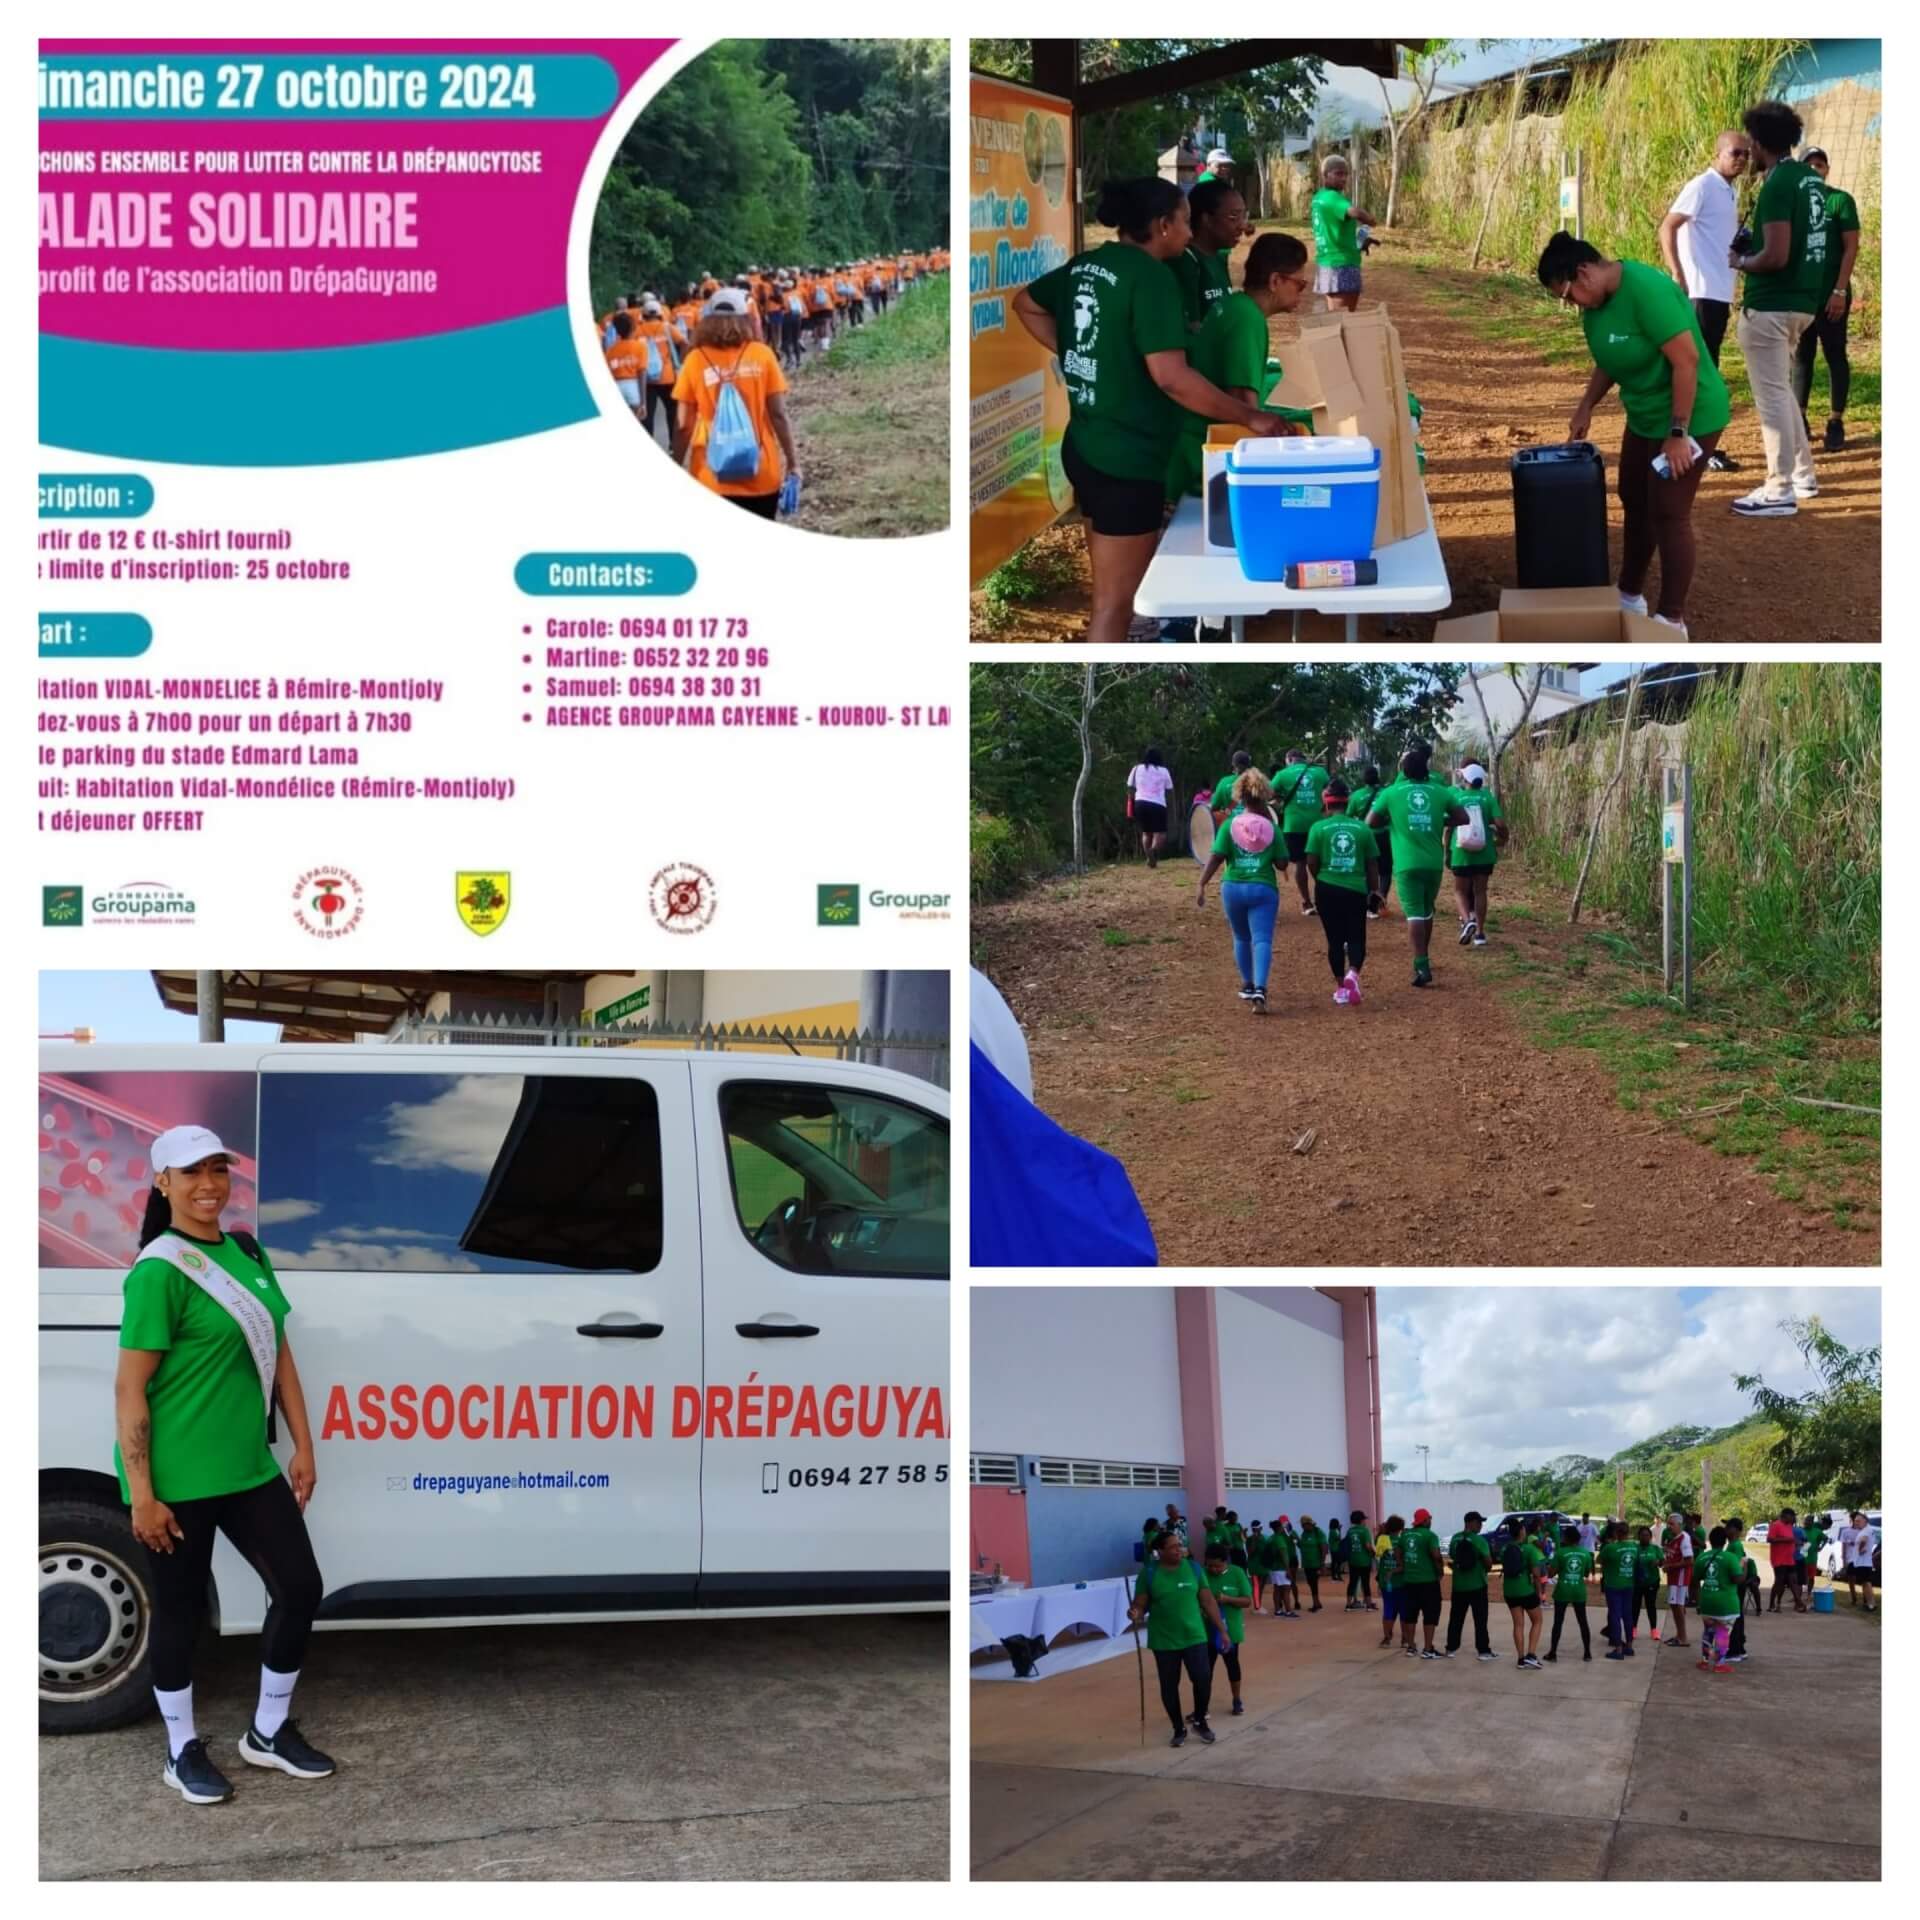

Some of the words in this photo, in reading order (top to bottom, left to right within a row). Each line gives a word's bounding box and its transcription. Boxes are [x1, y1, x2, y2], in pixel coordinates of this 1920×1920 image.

[38, 62, 205, 109] imanche
[217, 64, 264, 108] 27
[276, 64, 427, 109] octobre
[439, 64, 536, 108] 2024
[100, 150, 190, 173] ENSEMBLE
[194, 150, 240, 173] POUR
[243, 150, 304, 173] LUTTER
[308, 151, 373, 173] CONTRE
[376, 151, 398, 173] LA
[402, 146, 542, 173] DRÉPANOCYTOSE
[38, 191, 173, 248] ALADE
[188, 191, 419, 249] SOLIDAIRE
[38, 265, 96, 297] profit
[102, 266, 130, 293] de
[137, 265, 283, 293] l'association
[289, 264, 437, 297] DrépaGuyane
[38, 483, 120, 511] cription
[78, 529, 101, 550] de
[108, 530, 128, 550] 12
[134, 529, 146, 550] €
[152, 528, 221, 550] (t-shirt
[227, 529, 292, 550] fourni)
[49, 558, 105, 580] limite
[111, 558, 239, 583] d'inscription:
[246, 559, 269, 580] 25
[276, 559, 350, 580] octobre
[549, 563, 653, 587] Contacts:
[38, 621, 72, 644] art
[546, 617, 613, 639] Carole:
[619, 617, 667, 639] 0694
[672, 618, 693, 639] 01
[699, 617, 719, 639] 17
[725, 617, 748, 639] 73
[546, 646, 627, 668] Martine:
[633, 647, 681, 668] 0652
[686, 647, 710, 668] 32
[716, 647, 739, 668] 20
[745, 647, 769, 668] 96
[104, 679, 261, 700] VIDAL-MONDELICE
[267, 677, 279, 700] à
[285, 677, 444, 702] Rémire-Montjoly
[546, 676, 622, 697] Samuel:
[628, 676, 675, 697] 0694
[681, 676, 705, 697] 38
[711, 676, 735, 697] 30
[740, 676, 761, 697] 31
[38, 711, 121, 733] dez-vous
[127, 710, 139, 733] à
[145, 711, 192, 733] 7h00
[198, 714, 242, 736] pour
[248, 714, 272, 733] un
[278, 710, 341, 735] départ
[347, 710, 359, 733] à
[365, 711, 412, 733] 7h30
[546, 706, 612, 727] AGENCE
[618, 706, 716, 727] GROUPAMA
[722, 705, 799, 727] CAYENNE
[901, 706, 922, 727] ST
[928, 706, 950, 727] LA
[38, 745, 56, 766] le
[62, 743, 136, 769] parking
[142, 745, 165, 765] du
[171, 744, 225, 766] stade
[231, 744, 302, 766] Edmard
[309, 745, 359, 765] Lama
[38, 777, 70, 799] uit:
[76, 776, 174, 798] Habitation
[180, 775, 335, 798] Vidal-Mondélice
[341, 775, 515, 801] (Rémire-Montjoly)
[50, 809, 136, 833] déjeuner
[142, 810, 204, 831] OFFERT
[92, 896, 196, 917] Groupama
[320, 1384, 655, 1441] ASSOCIATION
[671, 1372, 950, 1440] DRÉPAGUYA
[788, 1466, 851, 1488] 0694
[858, 1465, 890, 1486] 27
[896, 1464, 927, 1484] 58
[934, 1464, 949, 1483] 5
